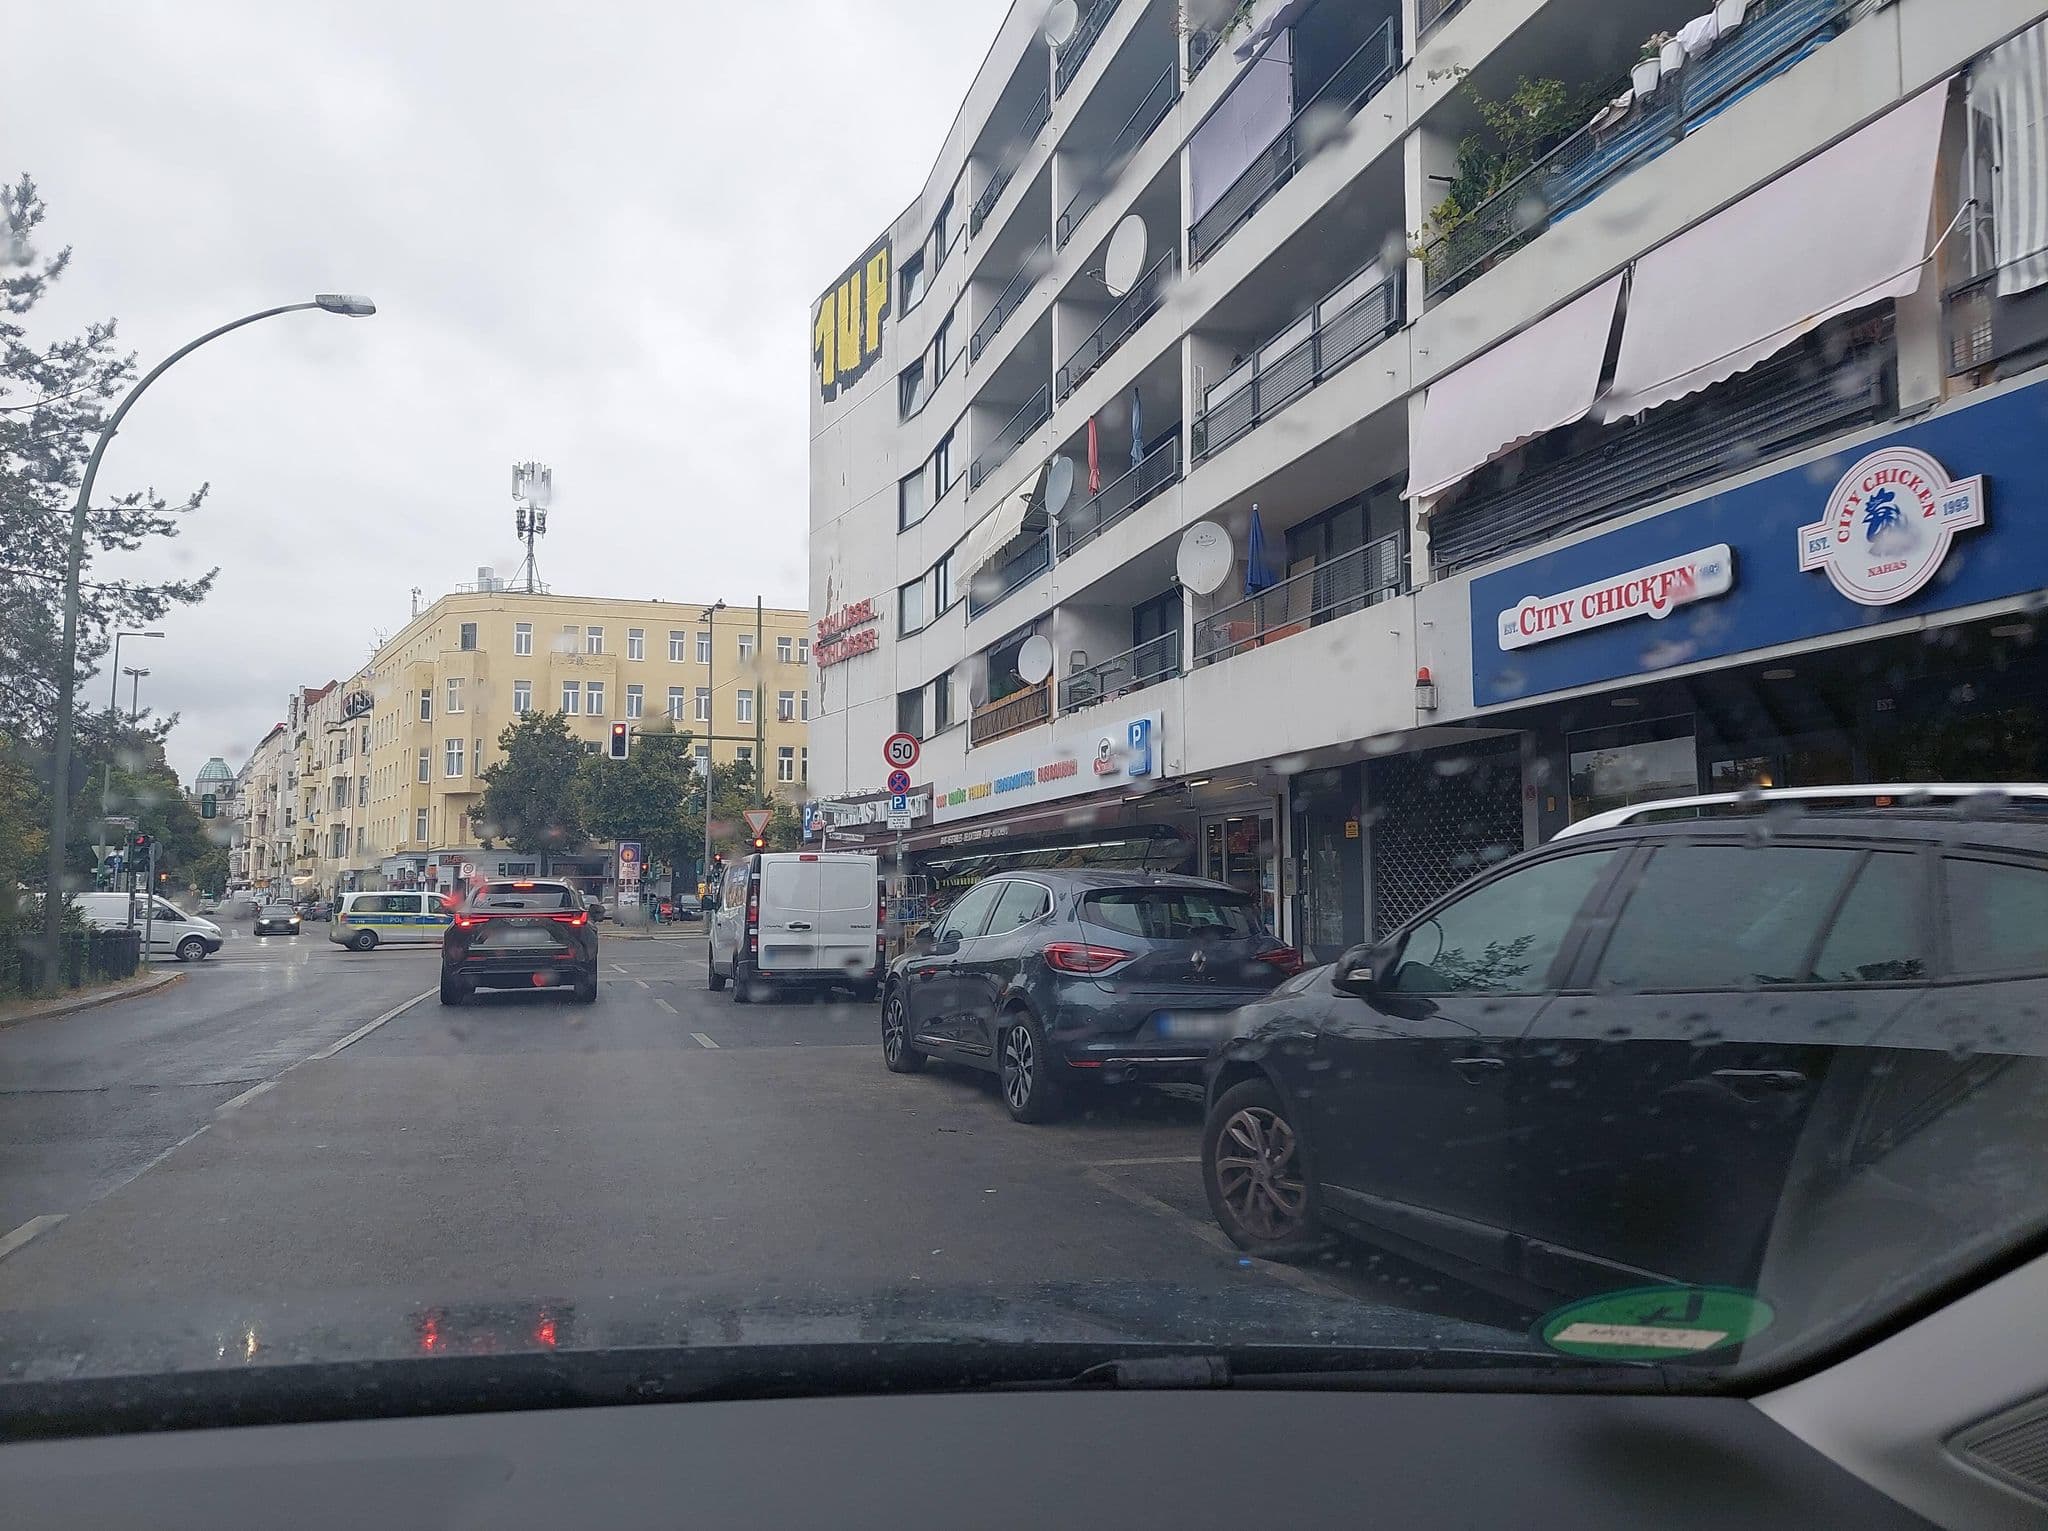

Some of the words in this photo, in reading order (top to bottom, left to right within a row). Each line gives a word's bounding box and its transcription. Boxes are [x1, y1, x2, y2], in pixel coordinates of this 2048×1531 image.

[814, 240, 889, 396] 1UP
[1838, 490, 1862, 543] CITY
[1861, 468, 1936, 519] CHICKEN
[1942, 496, 1969, 516] 1993
[1809, 537, 1831, 553] EST.
[1867, 560, 1907, 577] NAHAS
[1520, 600, 1574, 636] CITY
[1581, 564, 1697, 610] CHICKEN
[893, 743, 912, 759] 50
[894, 796, 902, 809] P
